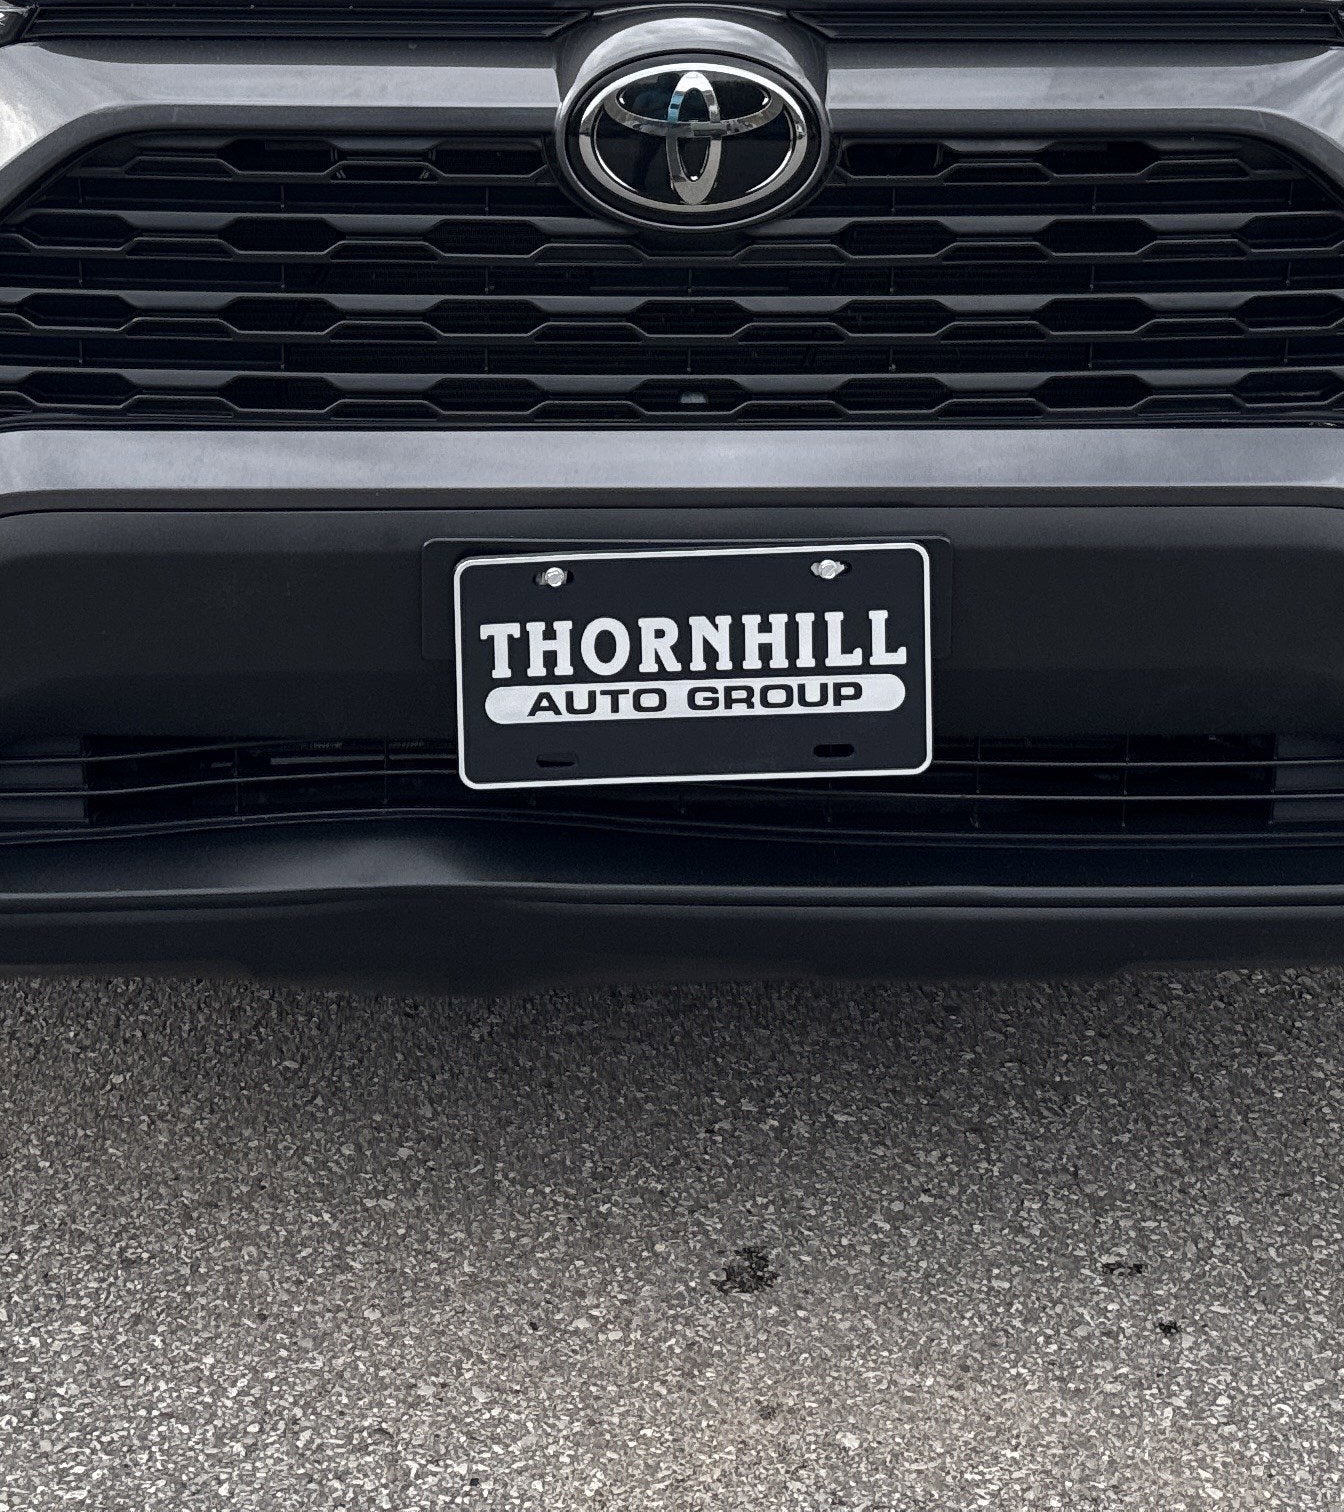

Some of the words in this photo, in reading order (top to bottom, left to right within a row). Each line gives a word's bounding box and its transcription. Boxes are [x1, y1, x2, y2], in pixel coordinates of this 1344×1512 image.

[479, 609, 907, 679] THORNHILL
[527, 687, 668, 717] AUTO
[686, 681, 863, 711] GROUP
